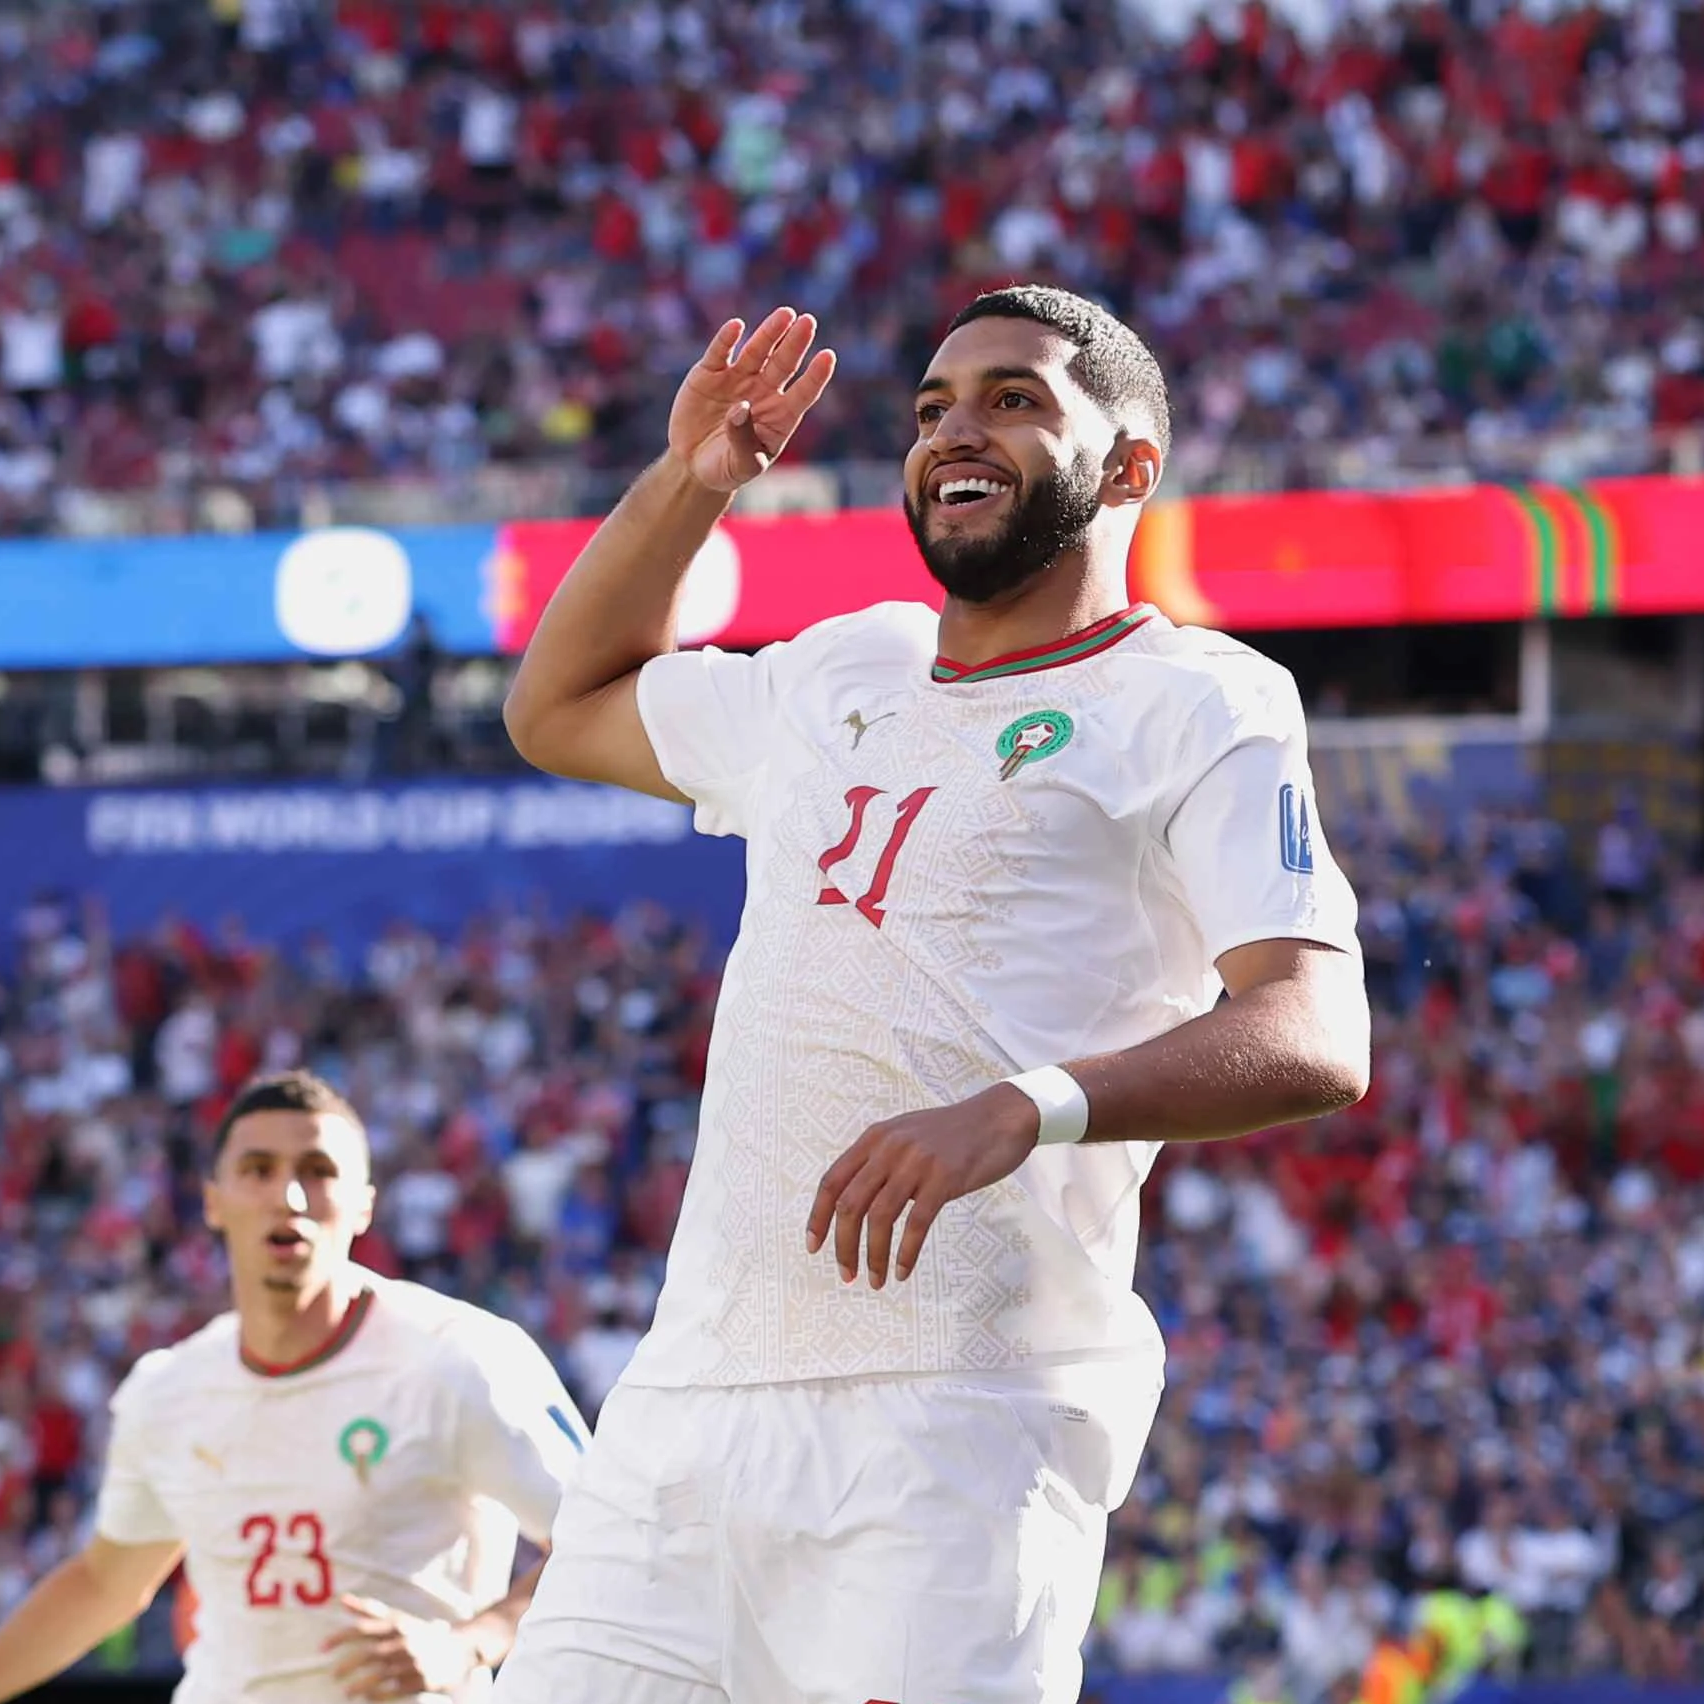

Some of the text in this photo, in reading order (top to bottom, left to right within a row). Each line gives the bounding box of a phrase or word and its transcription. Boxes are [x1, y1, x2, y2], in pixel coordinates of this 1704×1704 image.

[87, 792, 195, 851] FIFA
[208, 790, 385, 851] WORLD
[395, 788, 497, 851] CUP
[240, 1512, 333, 1607] 23
